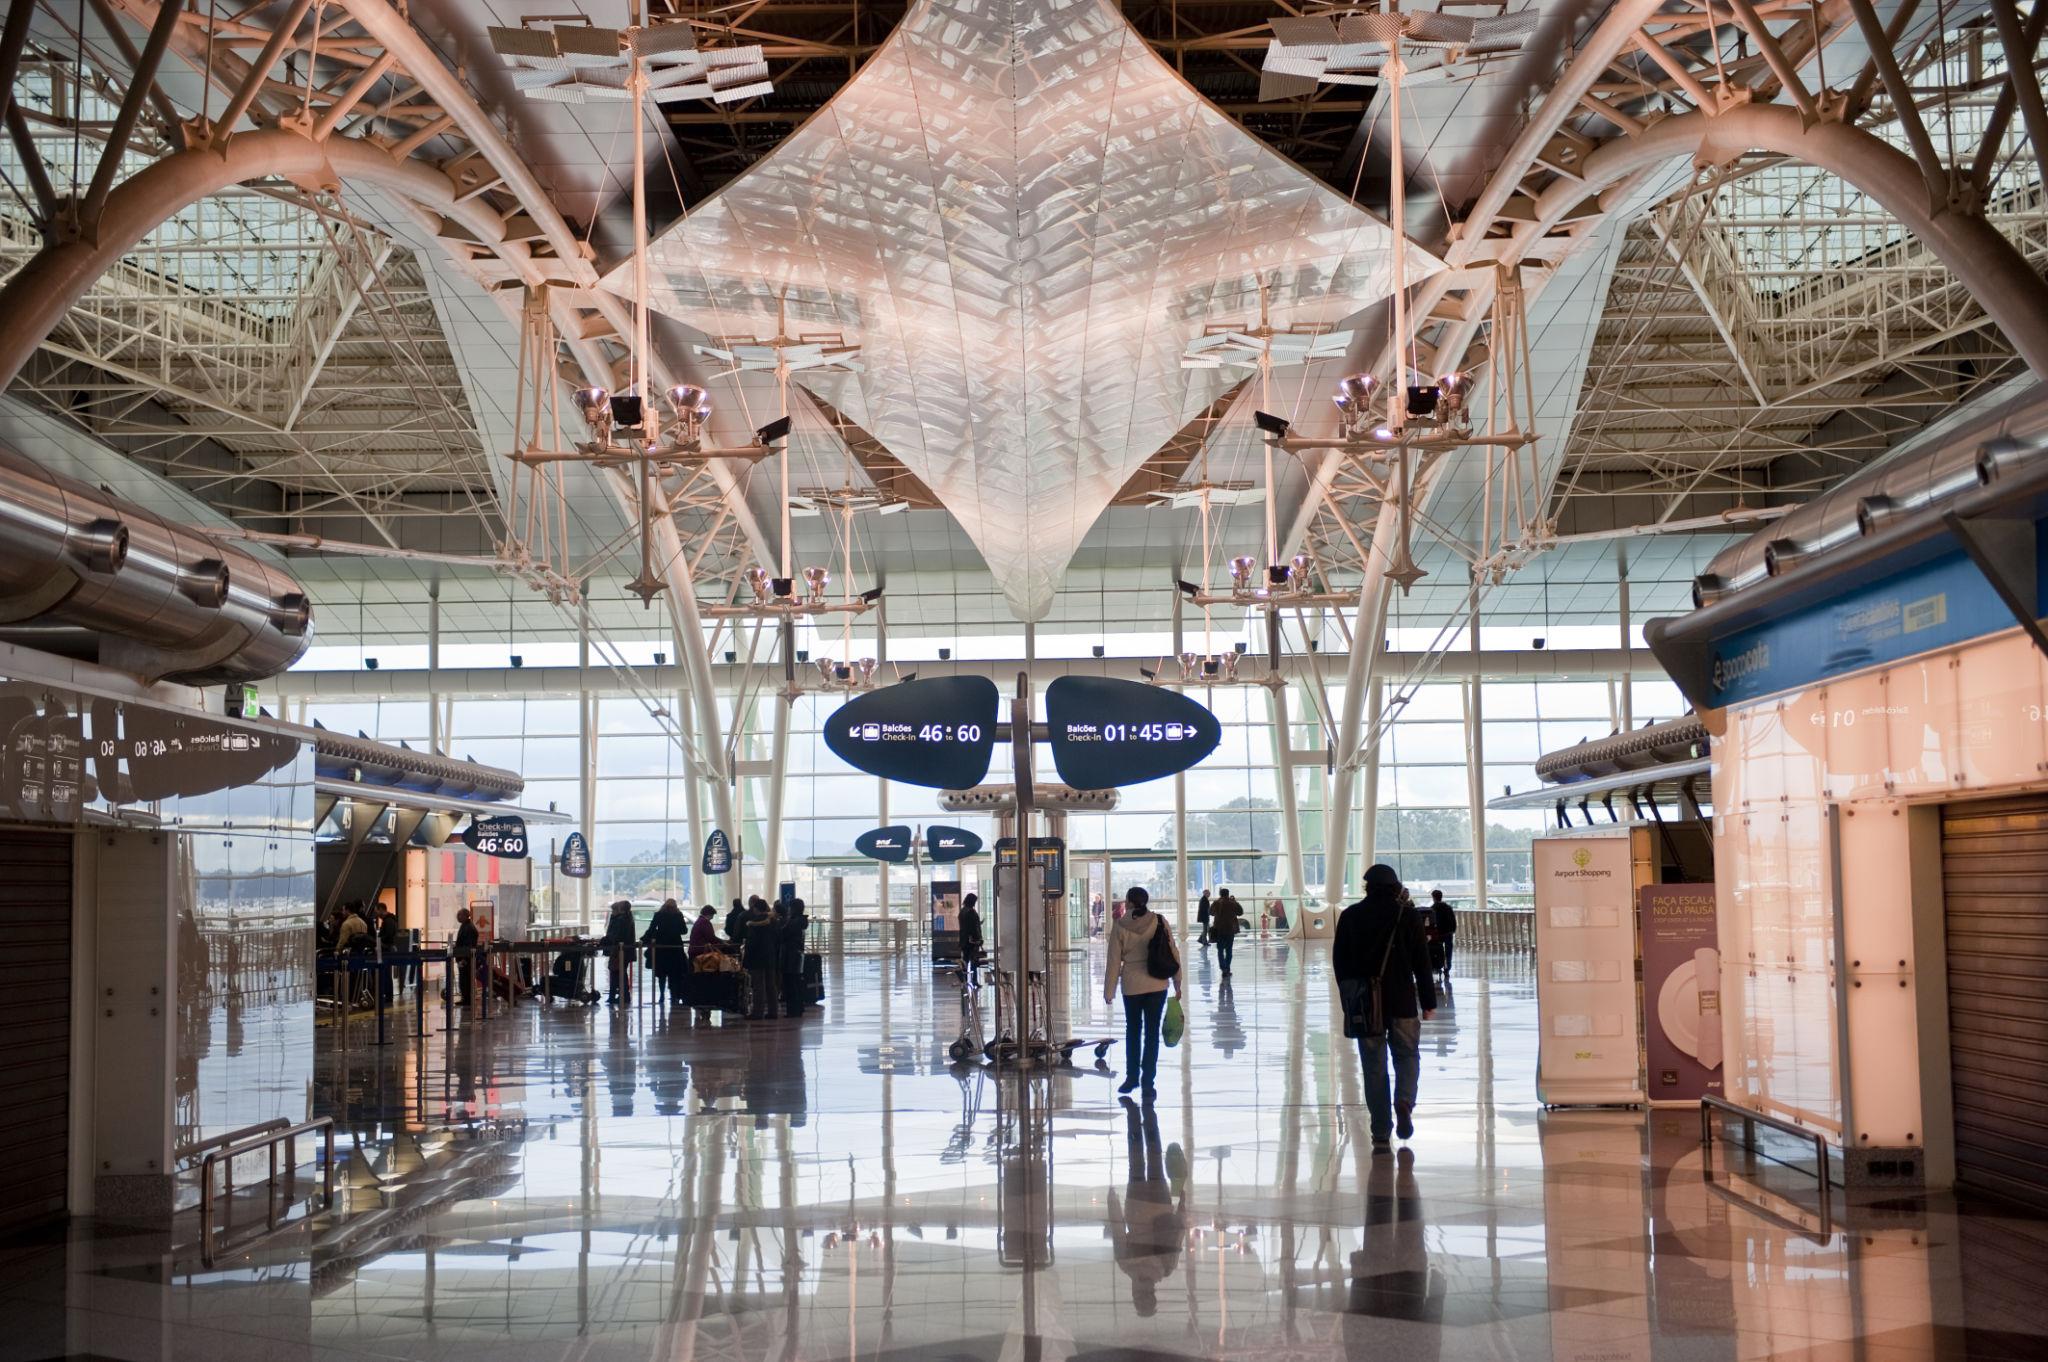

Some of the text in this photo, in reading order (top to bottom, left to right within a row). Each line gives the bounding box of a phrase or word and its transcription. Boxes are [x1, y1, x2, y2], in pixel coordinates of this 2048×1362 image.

[882, 724, 912, 732] Balcões
[919, 724, 943, 742] 46
[957, 724, 980, 742] 60
[1067, 724, 1097, 733] Balcões
[1104, 724, 1126, 742] 01
[1139, 724, 1163, 741] 45
[477, 823, 511, 831] Check-In
[477, 838, 497, 852] 46
[504, 838, 523, 852] 60
[1554, 869, 1612, 878] Airport Shopping
[1653, 896, 1715, 906] FAÇA ESCALA
[1653, 905, 1714, 915] NO LA PAUSA
